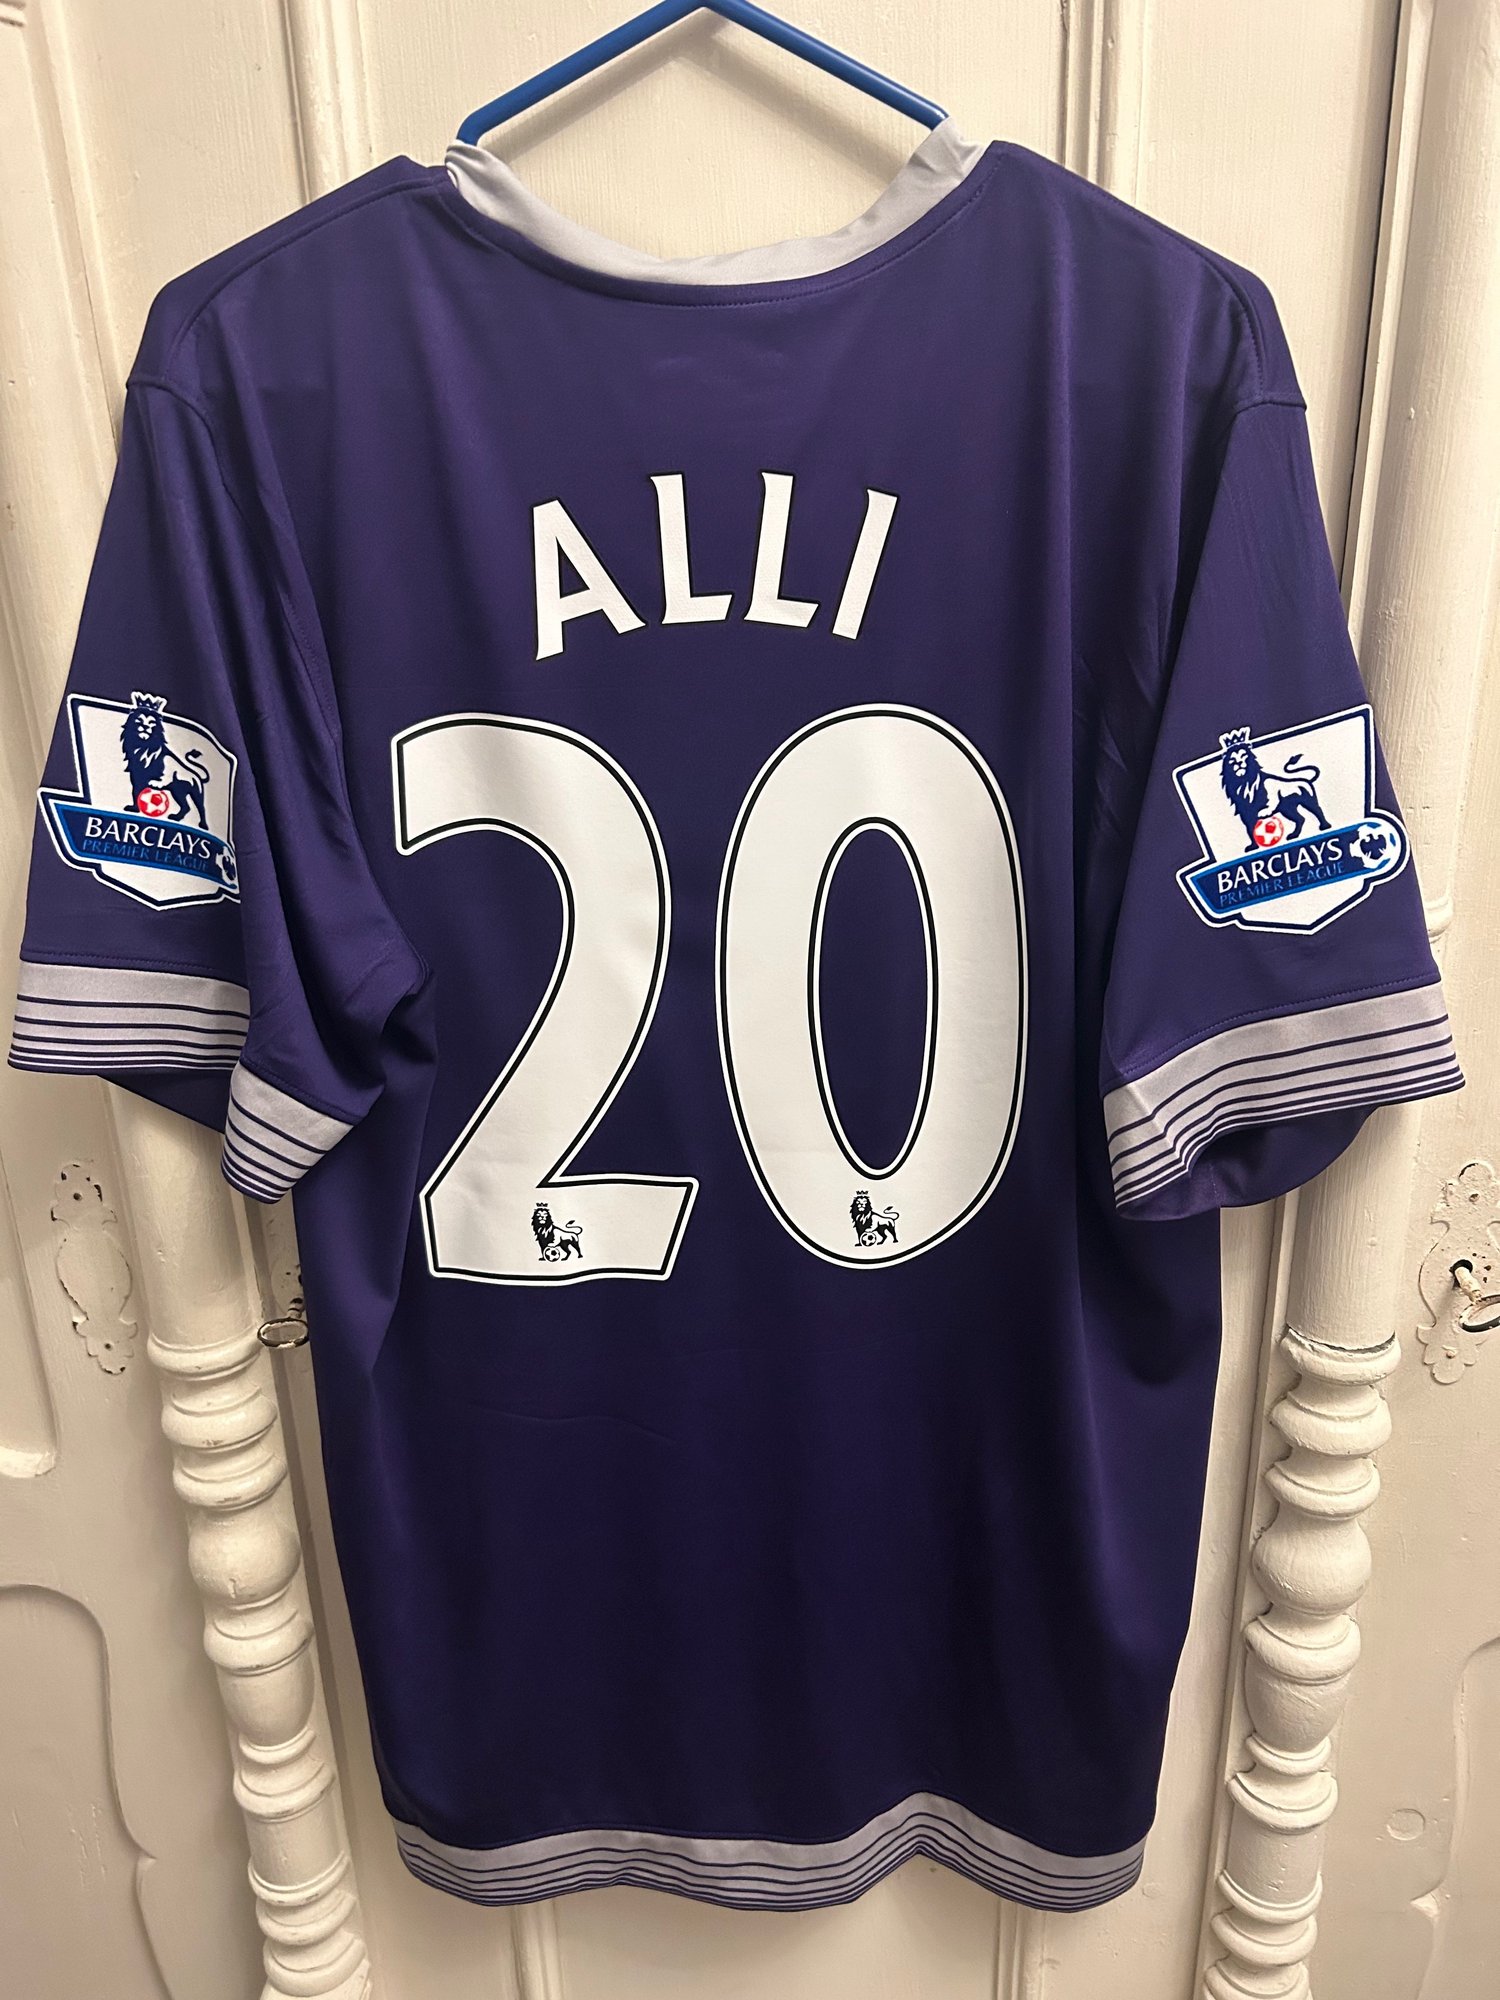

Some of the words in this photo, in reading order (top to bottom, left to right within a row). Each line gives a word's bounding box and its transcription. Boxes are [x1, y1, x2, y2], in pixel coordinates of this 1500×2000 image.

[533, 471, 898, 660] ALLI
[83, 839, 150, 860] PREMIER
[156, 848, 209, 871] LEAGUE
[85, 816, 211, 859] BARCLAYS
[1217, 838, 1343, 894] BARCLAYS
[1220, 879, 1283, 907] PREMIER
[1288, 861, 1345, 888] LEAGUE
[391, 702, 1029, 1285] 20
